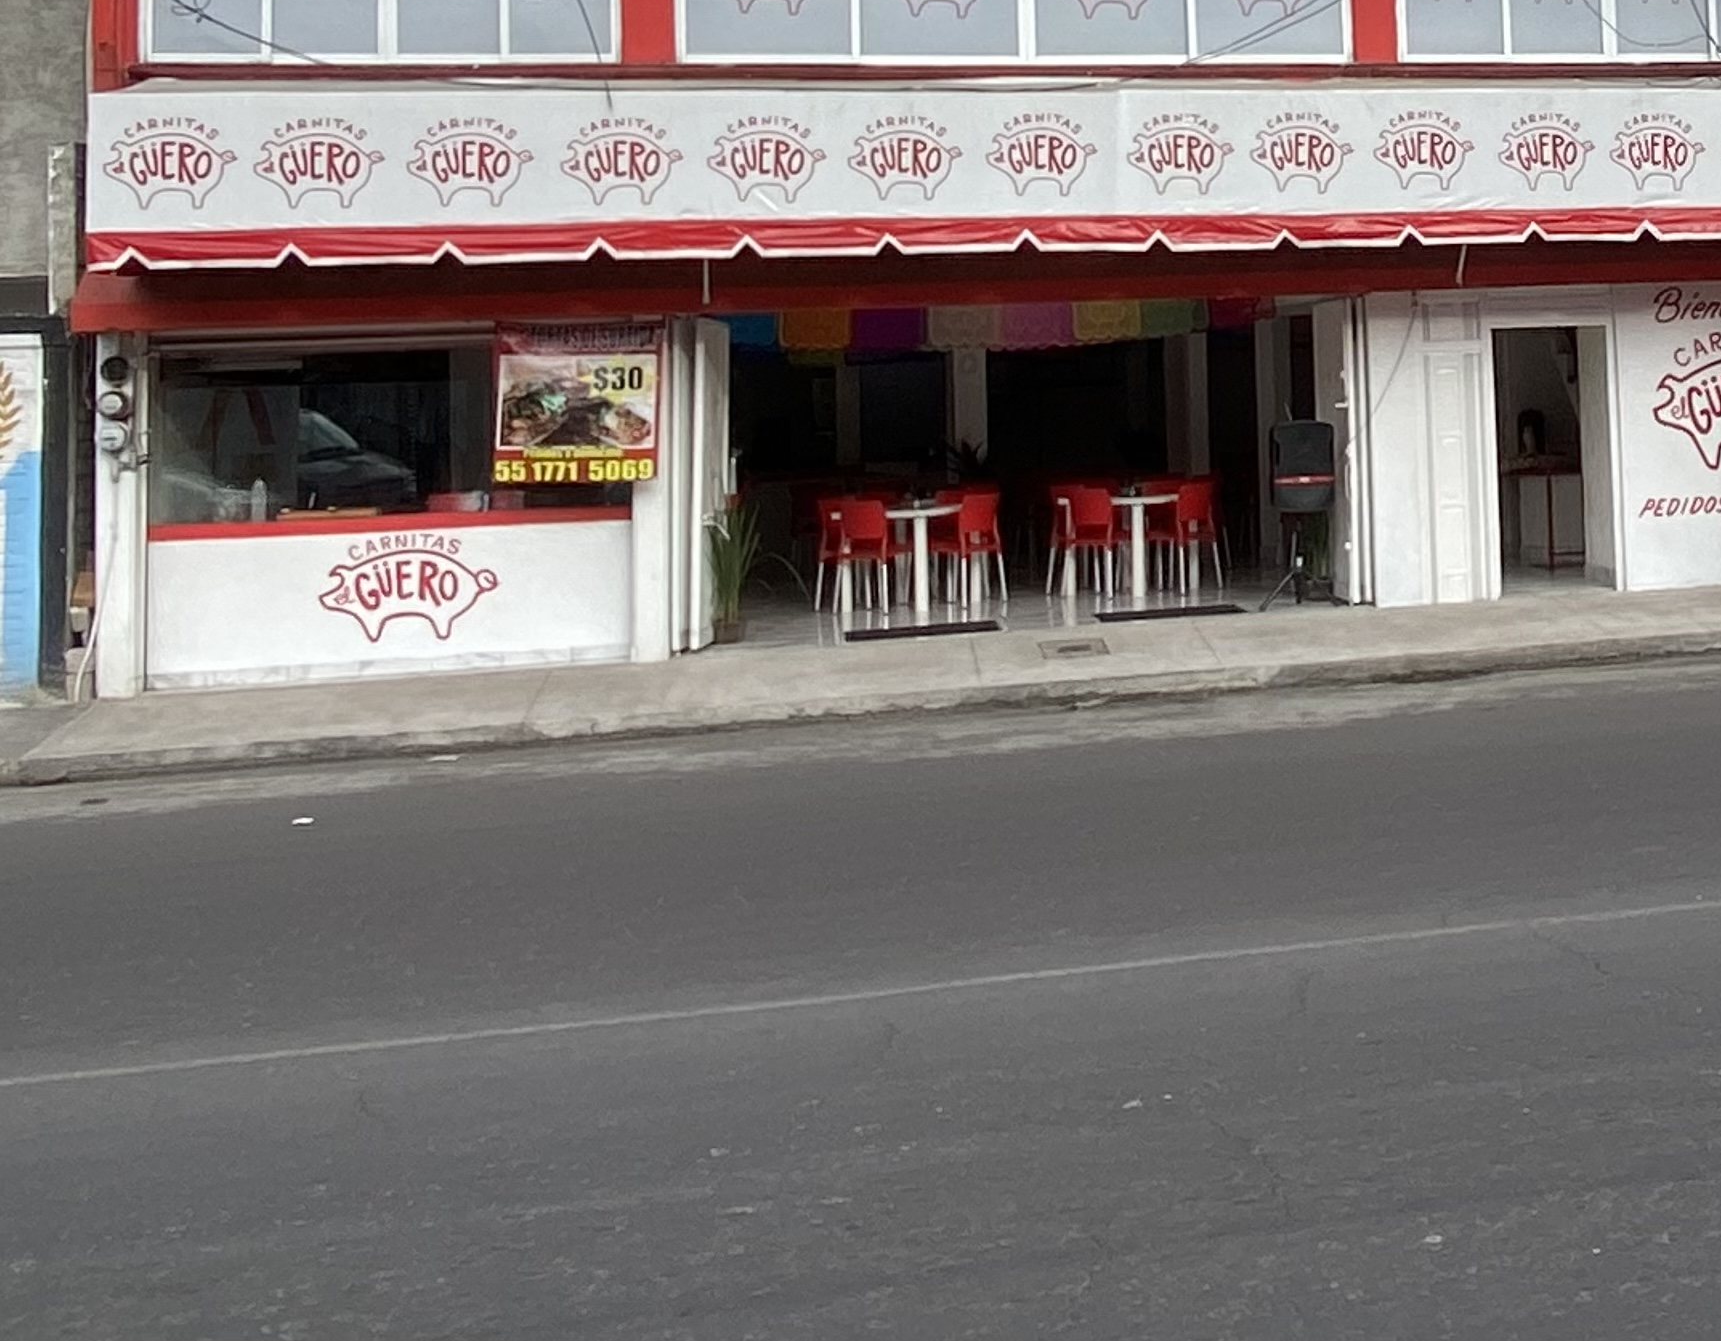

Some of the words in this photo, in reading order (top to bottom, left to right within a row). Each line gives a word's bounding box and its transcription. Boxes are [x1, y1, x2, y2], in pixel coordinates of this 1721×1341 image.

[124, 117, 219, 140] CARNITAS
[274, 118, 368, 140] CARNITAS
[427, 117, 517, 140] CARNITAS
[580, 118, 667, 140] CARNITAS
[727, 116, 811, 139] CARNITAS
[866, 116, 947, 137] CARNITAS
[1003, 113, 1083, 135] CARNITAS
[1266, 112, 1340, 133] CARNITAS
[1389, 111, 1461, 132] CARNITAS
[1511, 112, 1581, 132] CARNITAS
[1624, 112, 1693, 134] CARNITAS
[130, 141, 212, 186] GÜERO
[279, 141, 361, 185] GÜERO
[431, 140, 511, 183] GÜERO
[584, 140, 661, 182] GÜERO
[731, 138, 805, 181] GÜERO
[870, 137, 942, 179] GÜERO
[1008, 134, 1077, 176] GÜERO
[1148, 134, 1215, 174] GÜERO
[1270, 133, 1335, 172] GÜERO
[593, 366, 643, 392] $30
[1670, 397, 1689, 420] el
[495, 460, 526, 482] 55
[532, 461, 578, 481] 1771
[589, 459, 654, 481] 5069
[348, 533, 462, 561] CARNITAS
[355, 561, 458, 610] GÜERO
